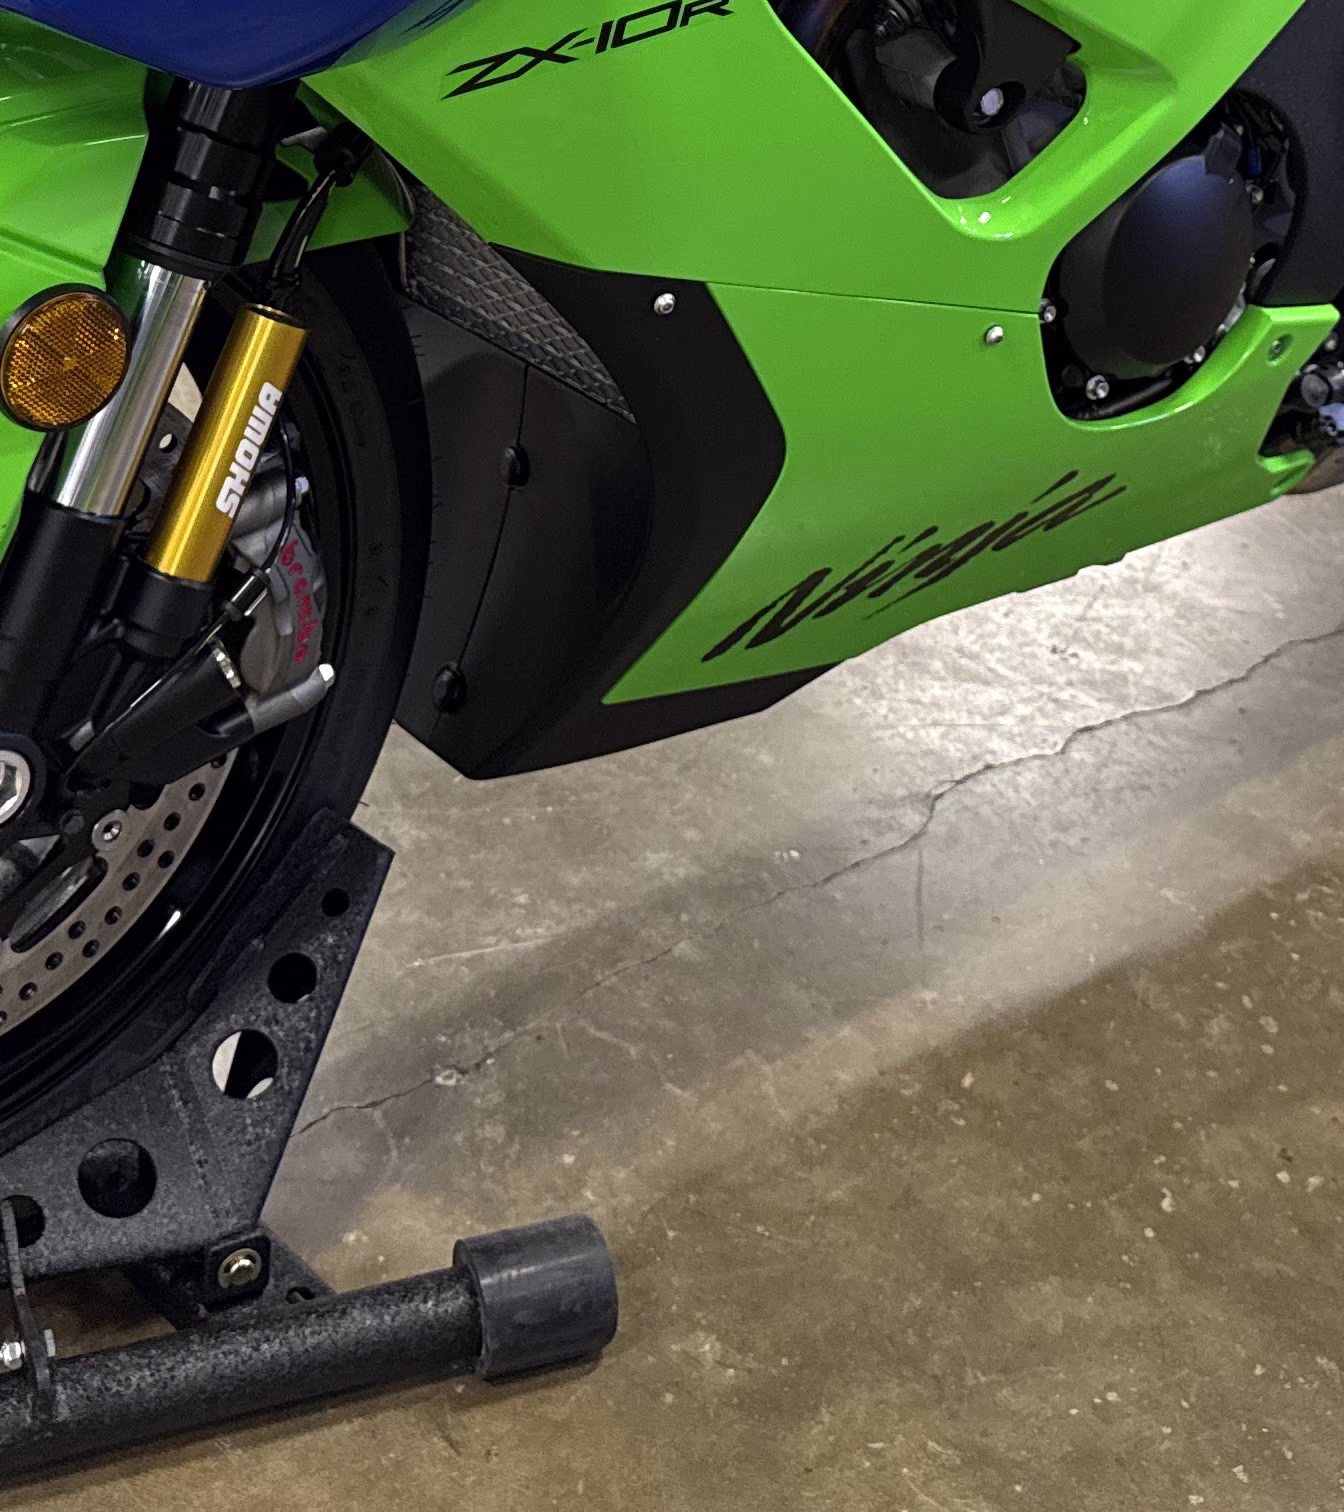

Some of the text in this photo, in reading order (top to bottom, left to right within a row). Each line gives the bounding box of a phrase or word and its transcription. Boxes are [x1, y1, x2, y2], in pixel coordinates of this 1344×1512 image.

[215, 381, 283, 519] SHOWA
[280, 539, 317, 665] brembo
[700, 470, 1127, 663] Ninja
